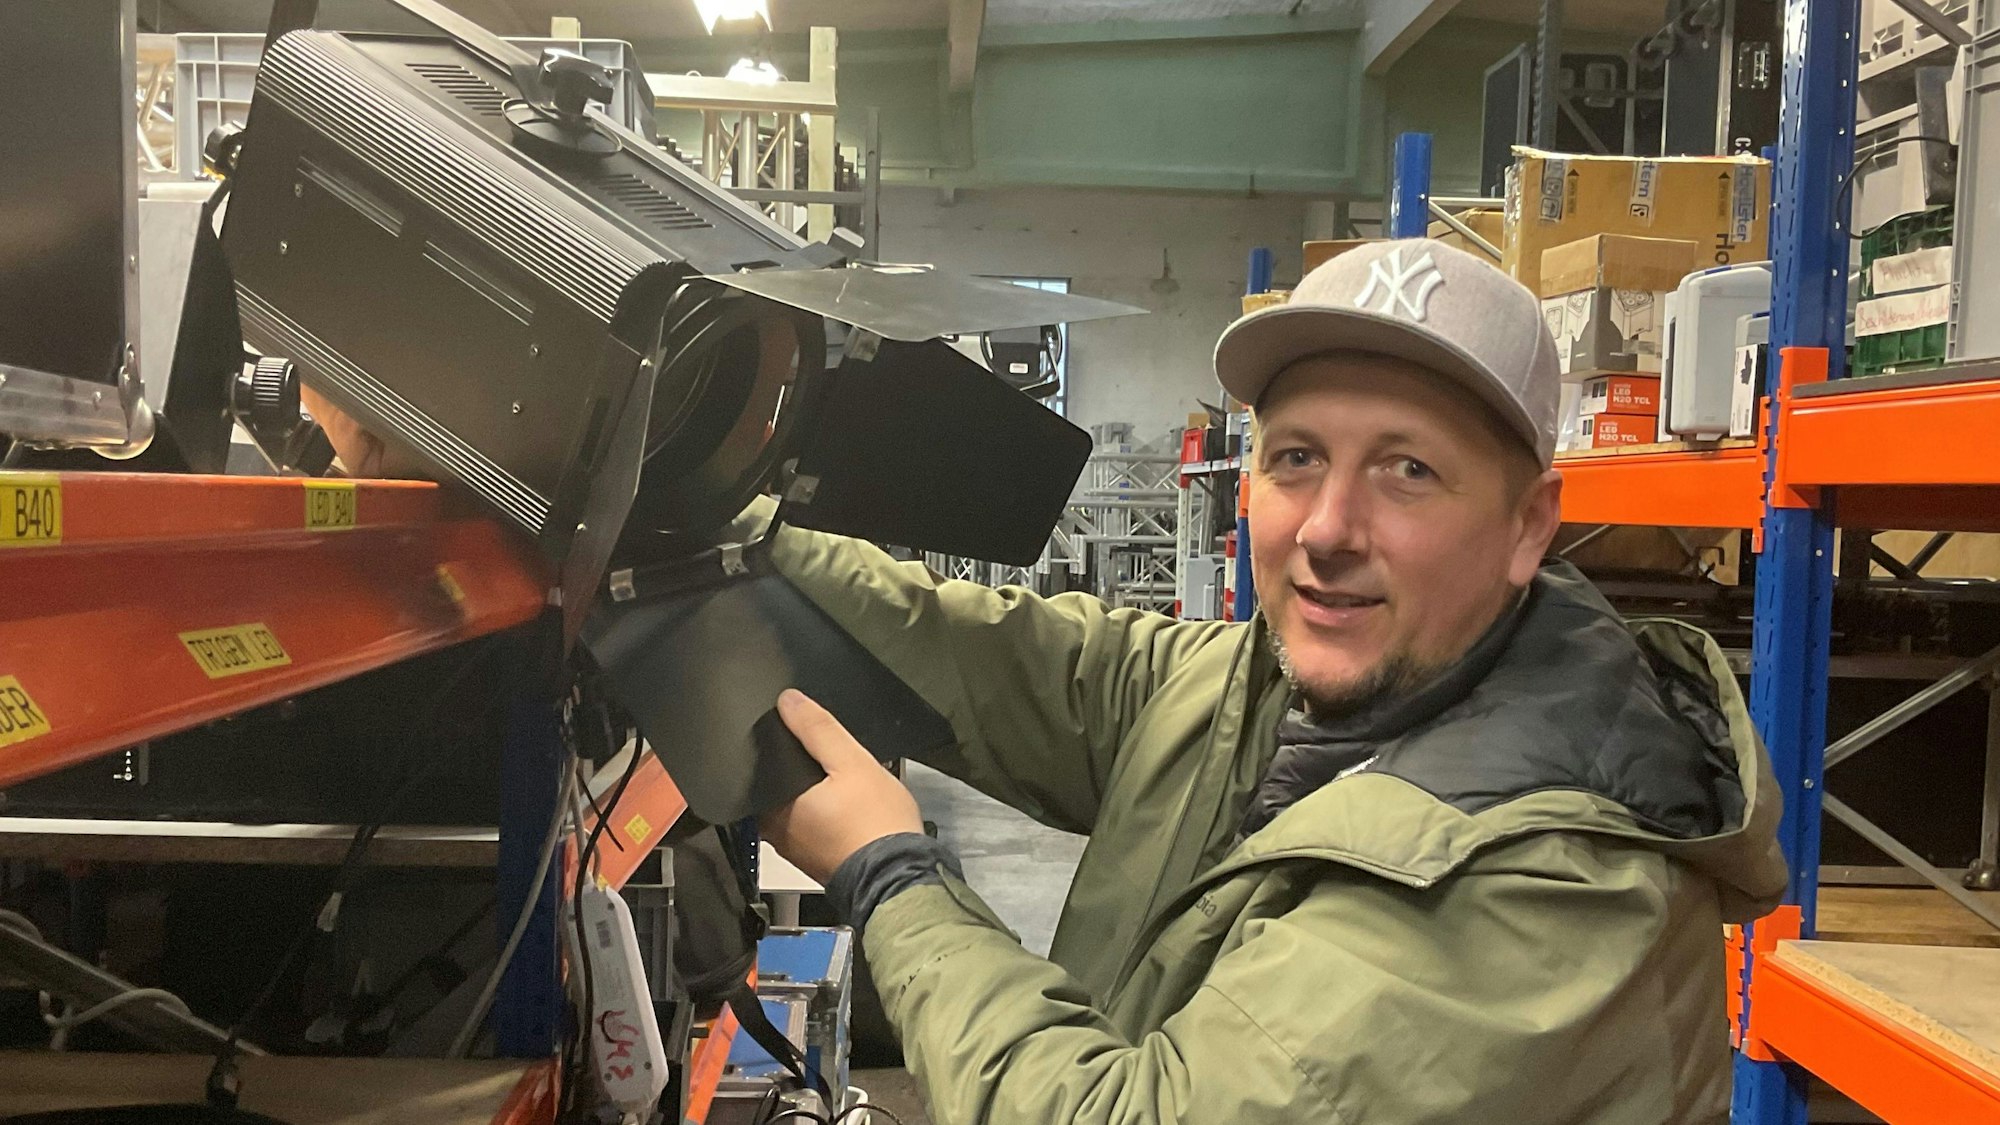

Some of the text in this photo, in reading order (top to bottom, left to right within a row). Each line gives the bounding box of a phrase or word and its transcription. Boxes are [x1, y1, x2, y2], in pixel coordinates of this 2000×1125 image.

[1353, 247, 1443, 321] NY
[1599, 425, 1618, 434] LED
[15, 488, 55, 537] B40
[311, 490, 330, 525] LED
[246, 630, 284, 661] LED
